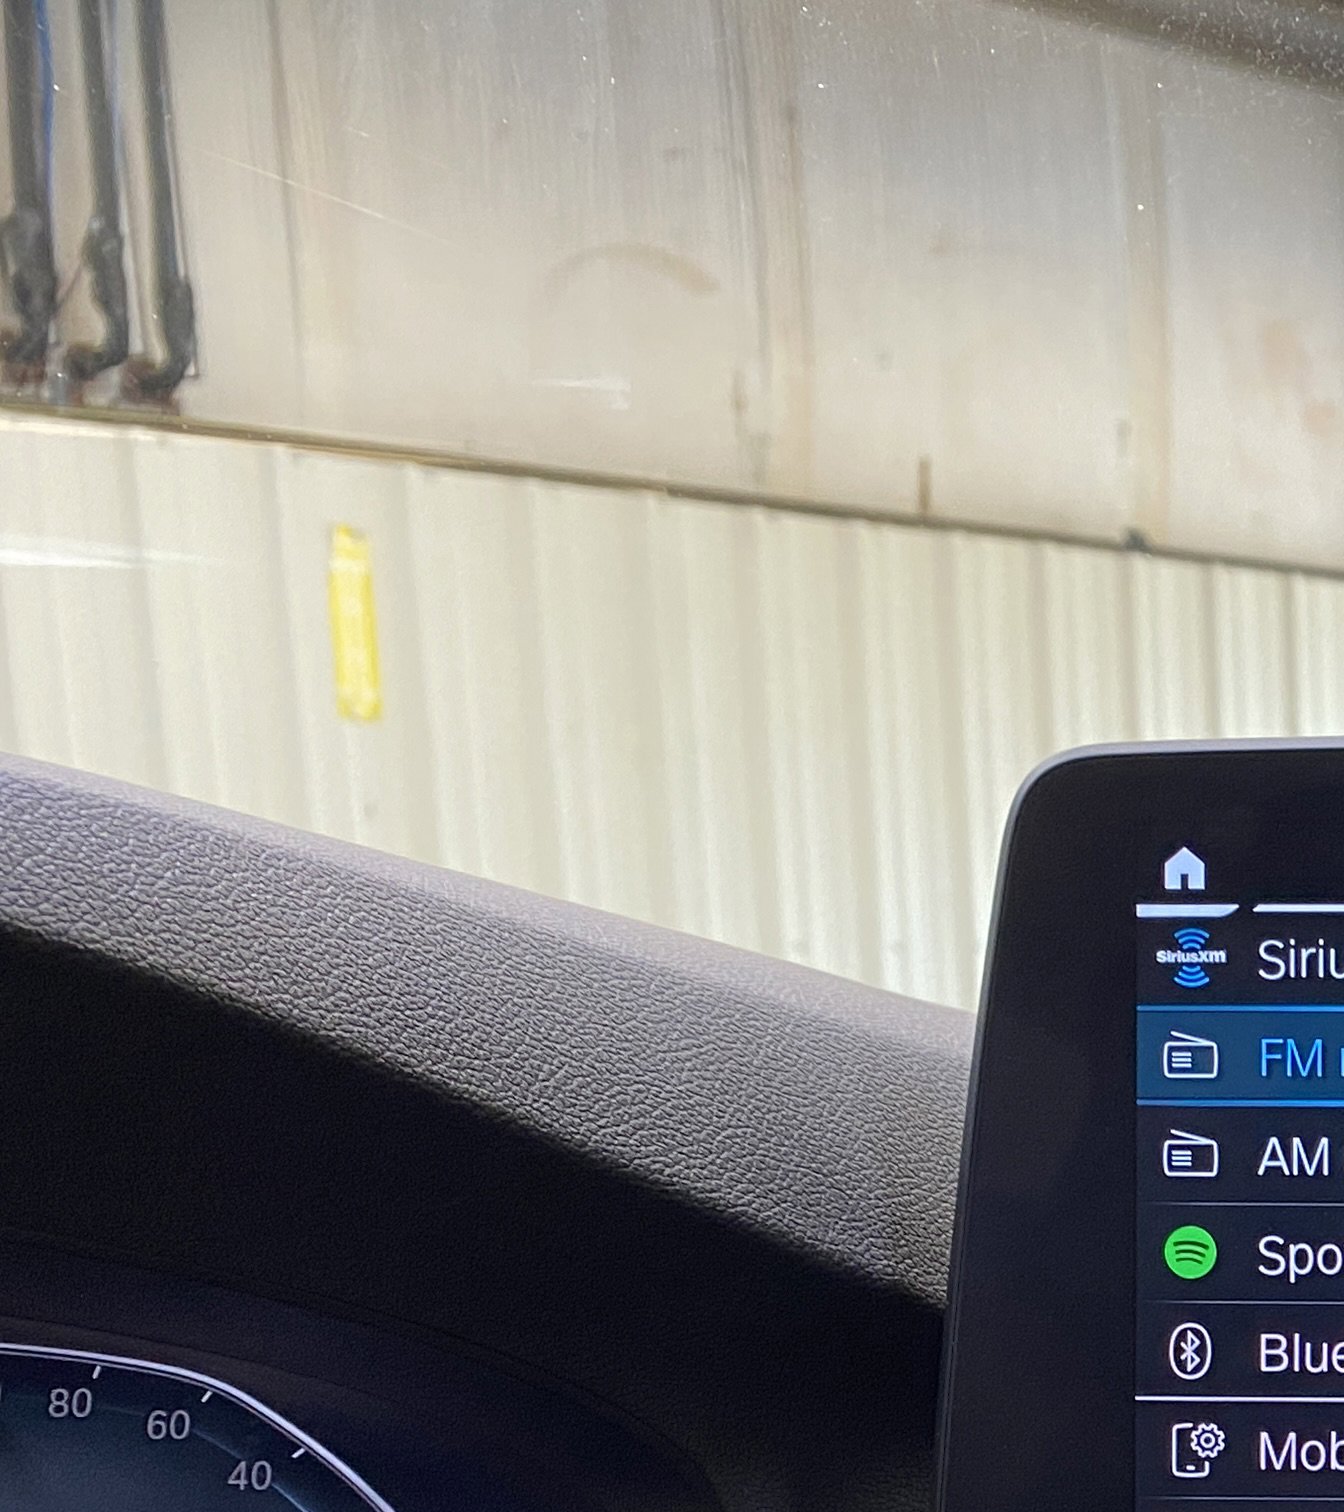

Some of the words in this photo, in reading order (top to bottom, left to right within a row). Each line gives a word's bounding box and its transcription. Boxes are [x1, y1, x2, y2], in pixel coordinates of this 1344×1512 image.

[1261, 1038, 1323, 1078] FM
[1257, 1136, 1329, 1177] AM
[48, 1387, 93, 1418] 80
[147, 1409, 191, 1440] 60
[227, 1461, 272, 1490] 40
